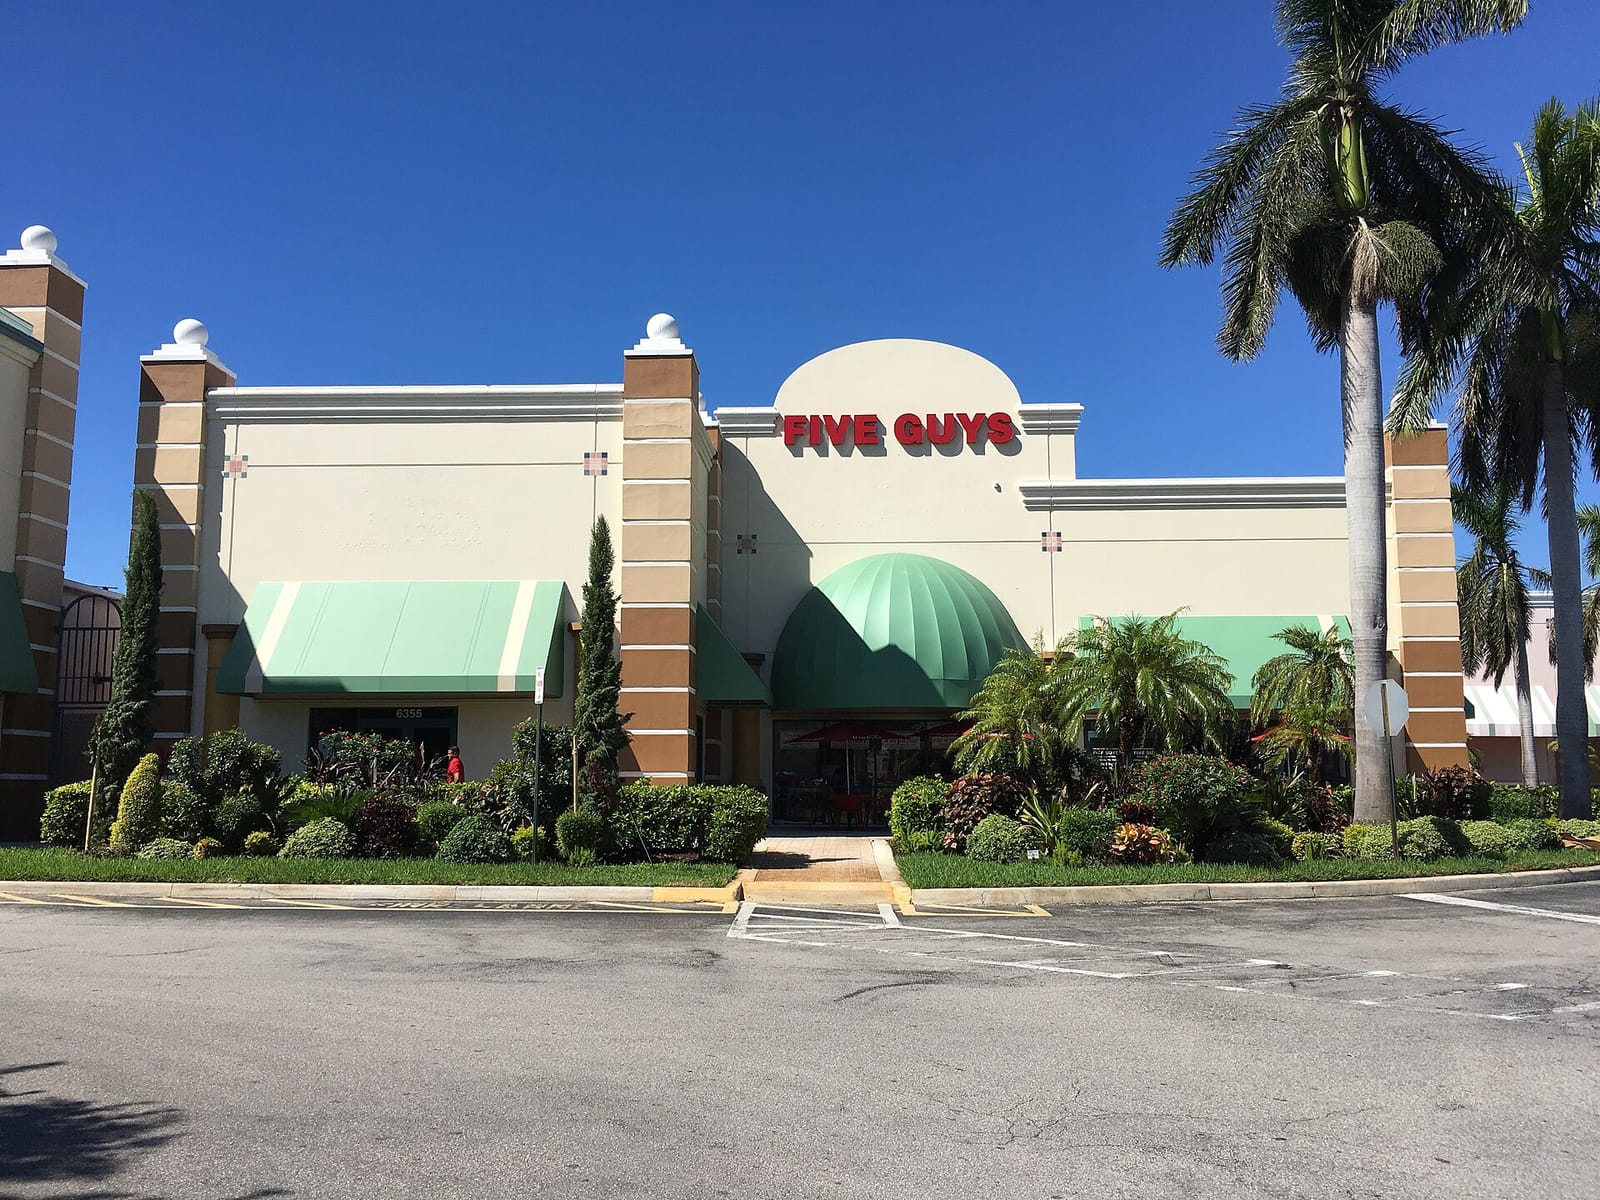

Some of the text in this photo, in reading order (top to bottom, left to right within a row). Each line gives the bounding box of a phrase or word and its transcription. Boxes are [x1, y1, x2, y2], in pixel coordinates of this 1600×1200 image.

[783, 412, 1015, 446] FIVE GUYS
[396, 709, 423, 719] 6355
